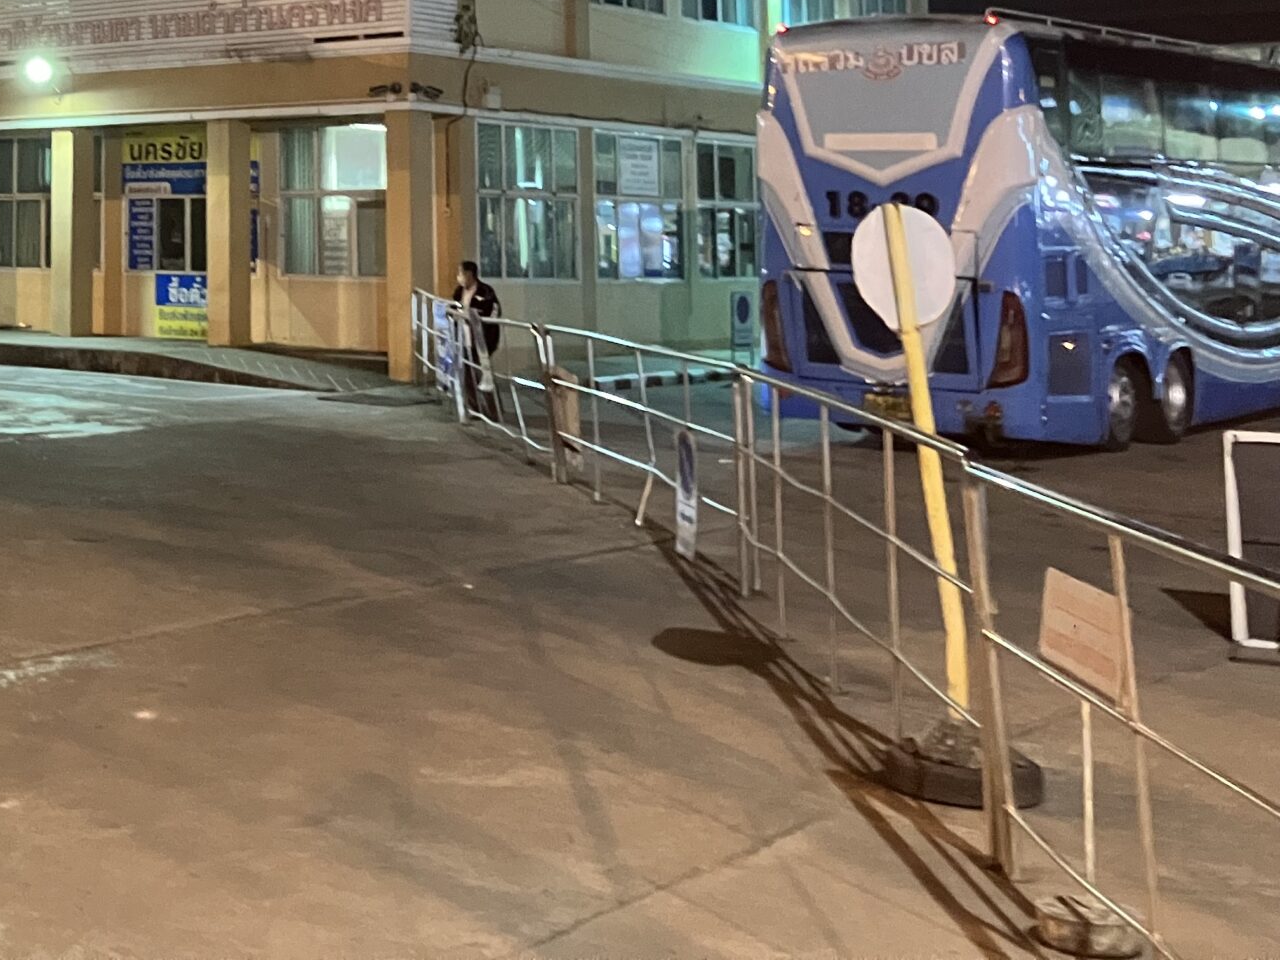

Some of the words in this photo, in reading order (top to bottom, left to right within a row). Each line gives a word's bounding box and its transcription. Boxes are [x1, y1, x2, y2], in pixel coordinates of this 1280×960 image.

[899, 41, 959, 66] บขส
[129, 136, 203, 161] นครชัย
